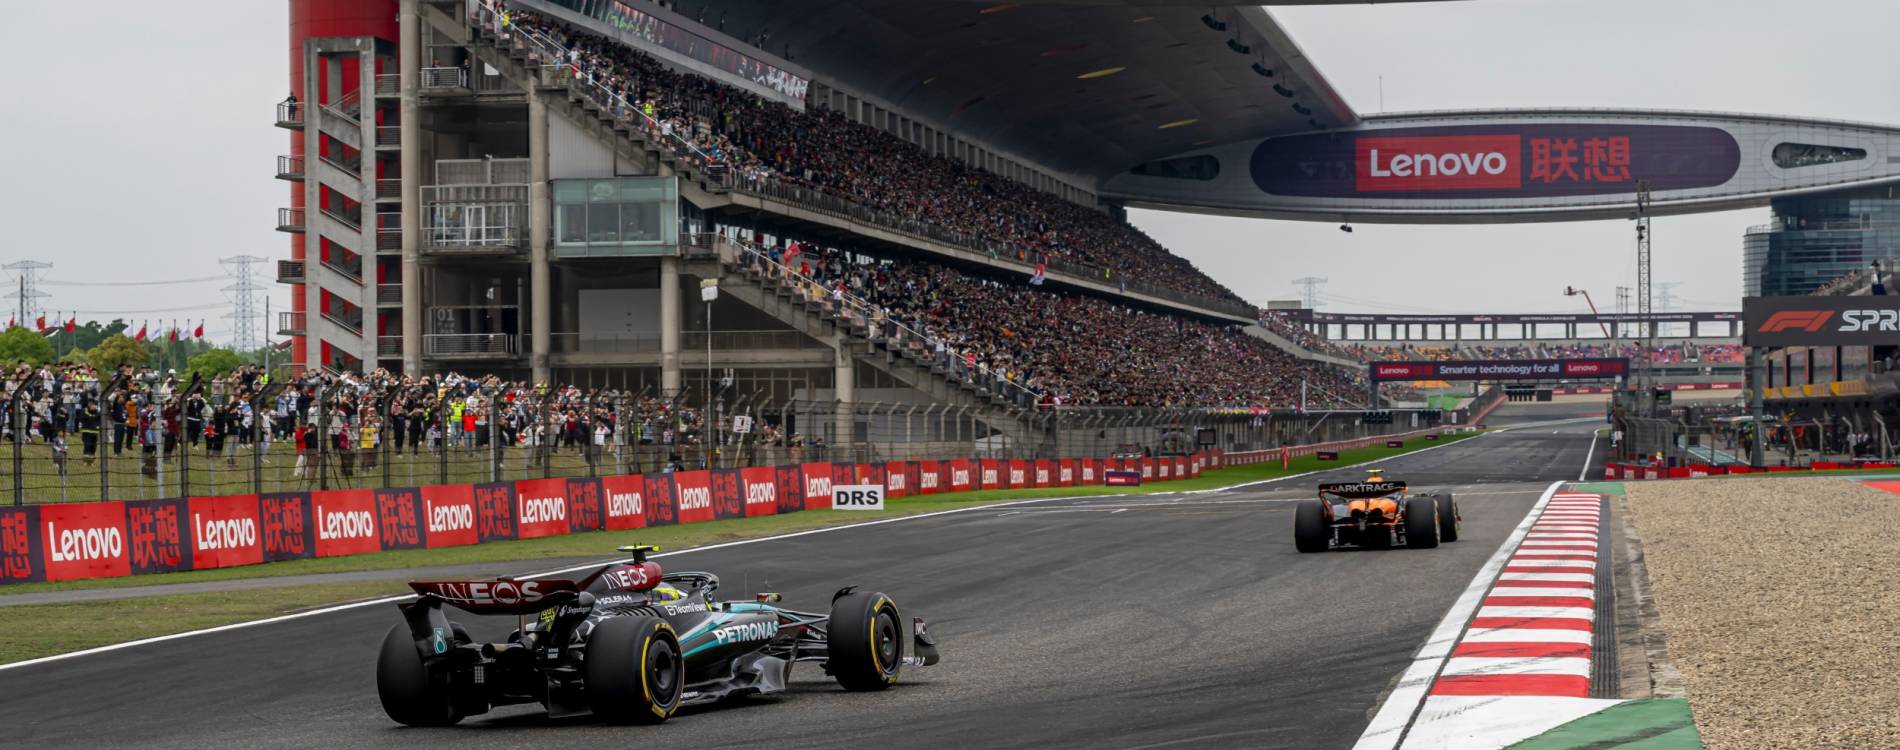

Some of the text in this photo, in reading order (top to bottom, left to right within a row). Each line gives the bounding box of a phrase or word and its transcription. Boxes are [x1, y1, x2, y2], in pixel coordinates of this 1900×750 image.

[1370, 149, 1507, 177] Lenovo
[1529, 136, 1632, 183] 联想
[437, 309, 455, 321] 01
[1379, 366, 1409, 375] Lenovo
[1439, 365, 1477, 375] Smarter
[1479, 364, 1532, 378] technology
[1533, 364, 1547, 374] for
[1548, 363, 1559, 373] all
[1568, 363, 1598, 372] Lenovo
[677, 483, 710, 511] Lenovo
[744, 478, 775, 505] Lenovo
[805, 473, 832, 498] Lenovo
[836, 490, 879, 506] DRS
[1330, 482, 1394, 493] DARKTRACE
[427, 499, 473, 533] Lenovo
[476, 486, 511, 538] 联想
[519, 493, 565, 524] Lenovo
[568, 481, 600, 529] 联想
[606, 488, 642, 517] Lenovo
[195, 513, 256, 551] Lenovo
[262, 497, 305, 555] 联想
[318, 505, 374, 540] Lenovo
[377, 492, 419, 546] 联想
[49, 521, 122, 562] Lenovo
[129, 504, 181, 569] 联想
[436, 581, 544, 605] INEOS
[602, 567, 648, 591] INEOS
[676, 602, 707, 615] TeamViewe
[712, 620, 779, 645] PETRONAS
